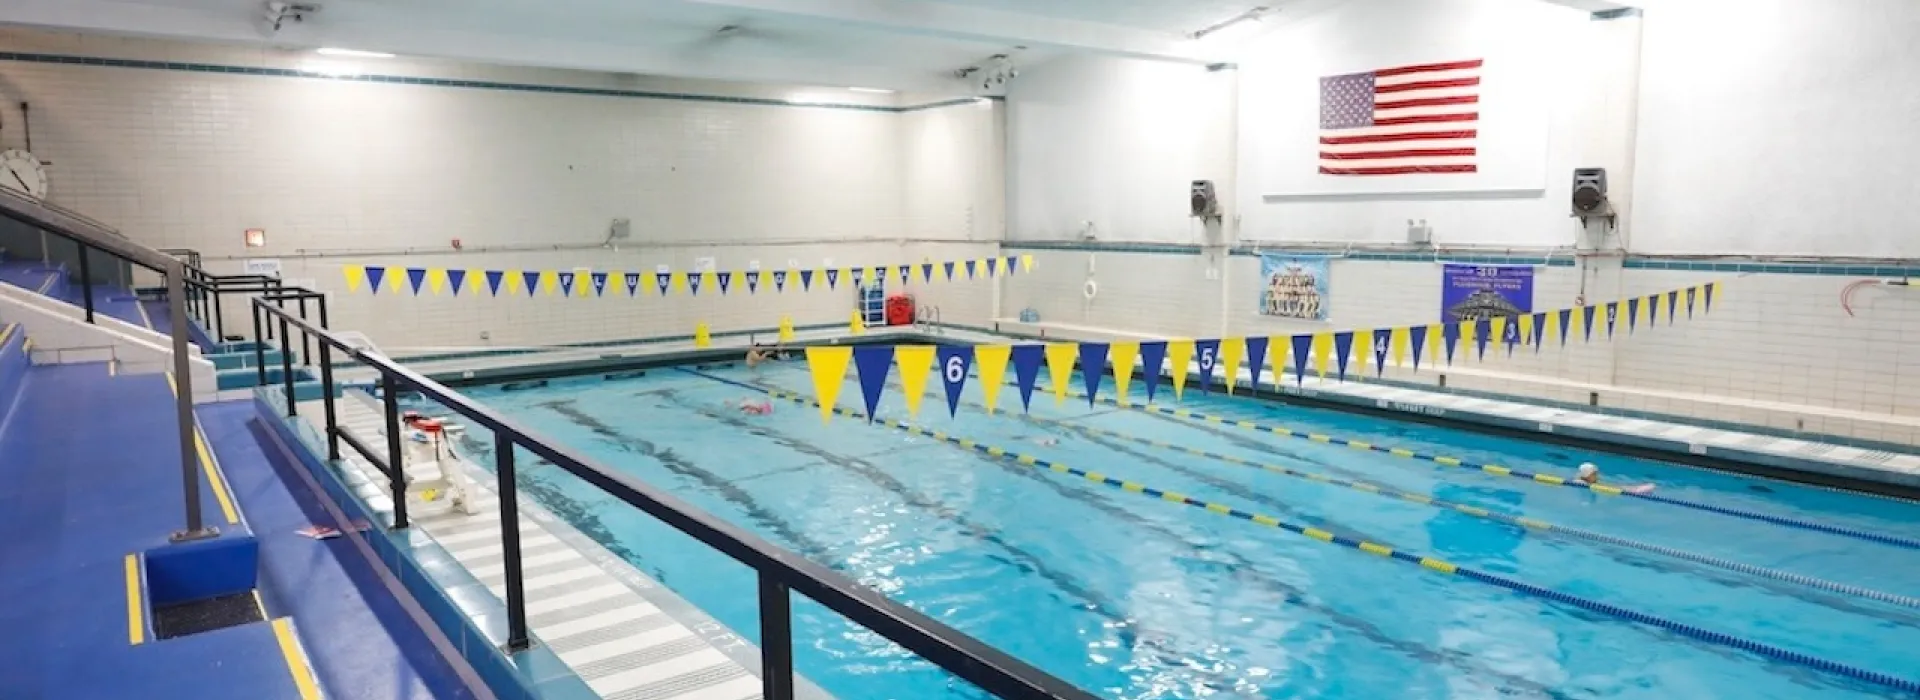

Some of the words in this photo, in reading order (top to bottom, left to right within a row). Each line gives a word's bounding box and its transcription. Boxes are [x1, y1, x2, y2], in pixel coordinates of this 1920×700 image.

[1507, 322, 1516, 339] 3
[1376, 336, 1386, 354] 4
[1201, 347, 1213, 370] 5
[946, 356, 964, 382] 6
